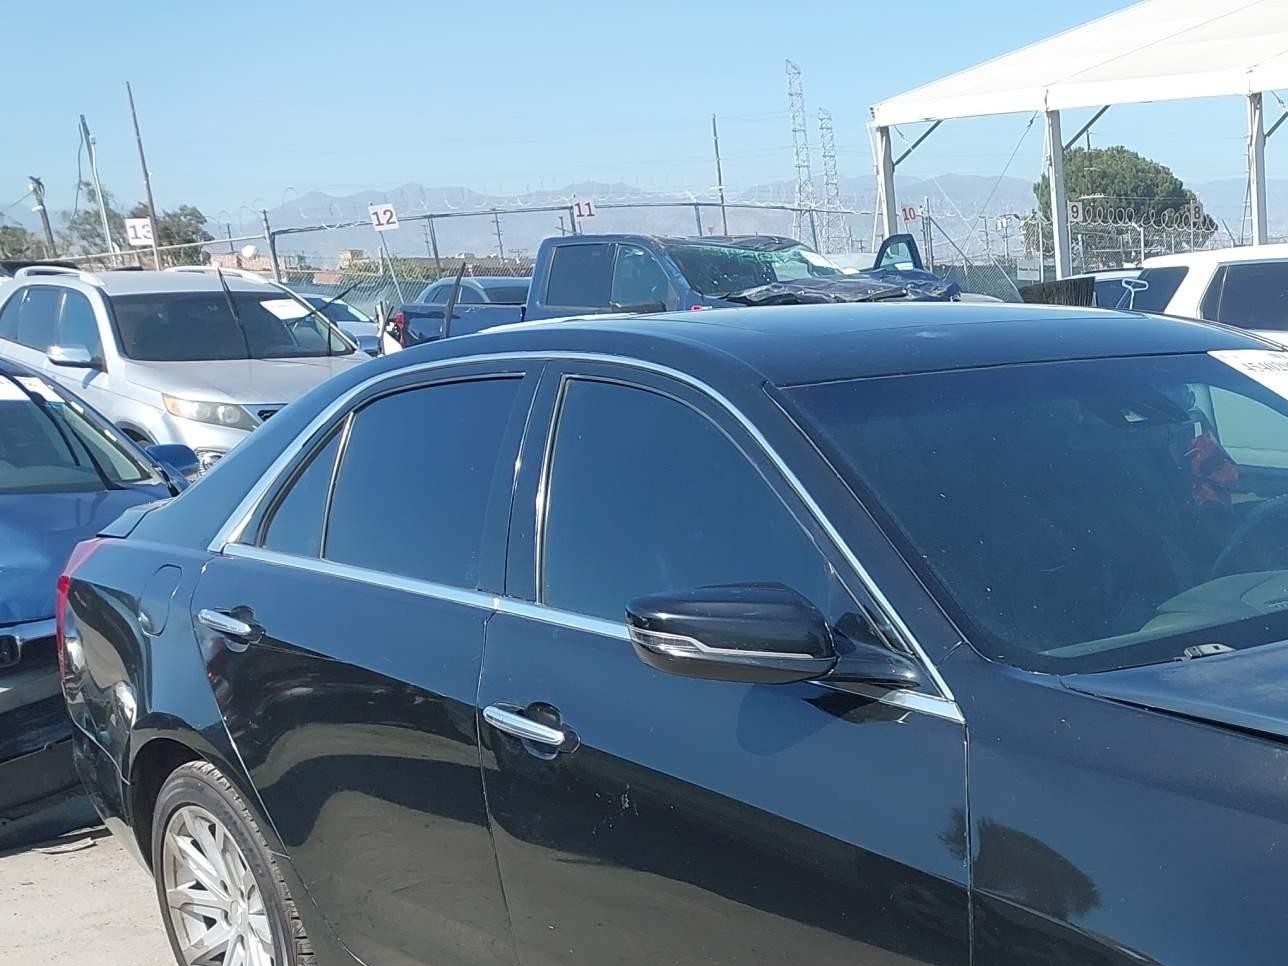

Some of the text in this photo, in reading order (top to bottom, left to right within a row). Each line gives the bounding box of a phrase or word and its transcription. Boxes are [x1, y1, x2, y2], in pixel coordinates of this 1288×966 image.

[574, 202, 595, 217] 11
[902, 207, 916, 220] 10
[1071, 204, 1079, 219] 9
[1193, 205, 1201, 219] 8
[371, 209, 396, 226] 12
